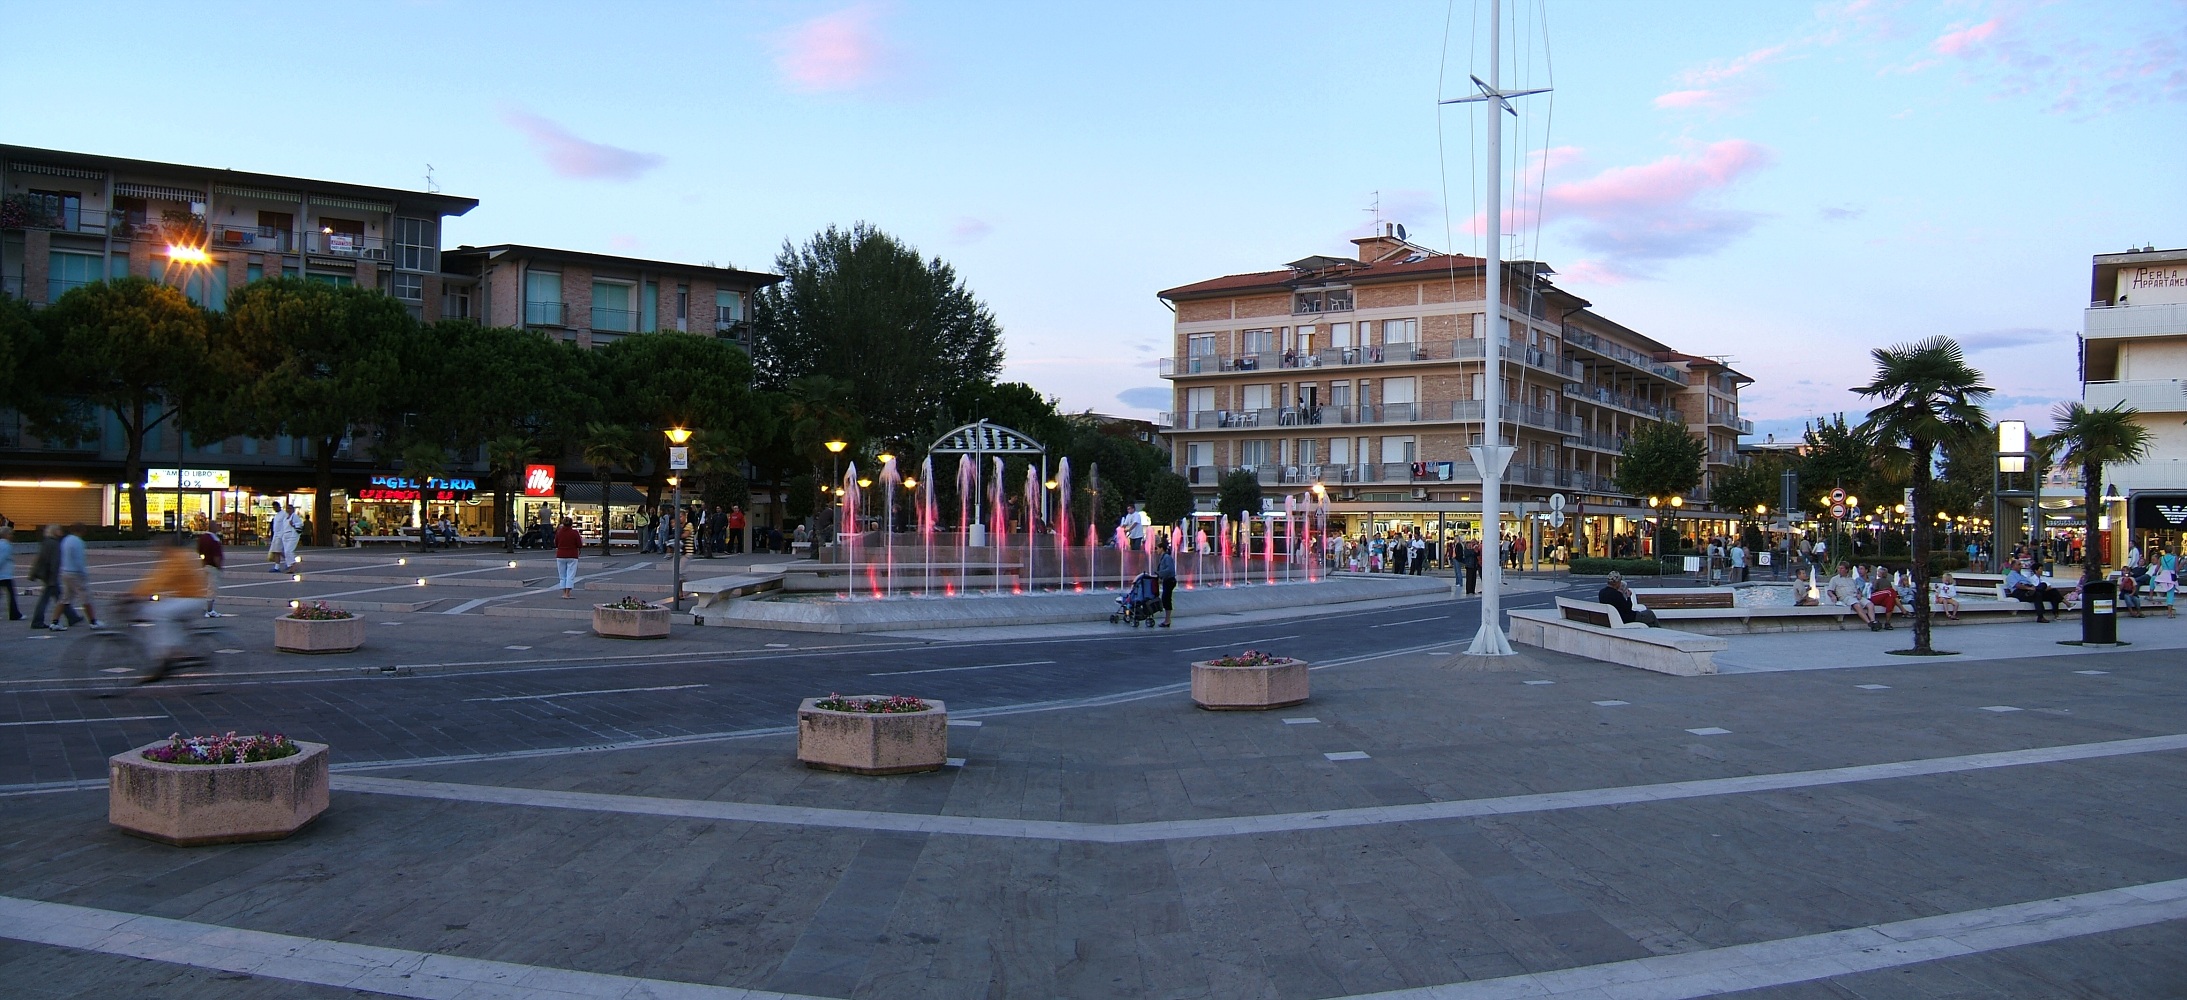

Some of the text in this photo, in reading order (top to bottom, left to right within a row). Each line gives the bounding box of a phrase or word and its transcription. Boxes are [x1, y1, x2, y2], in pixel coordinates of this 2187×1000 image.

[371, 476, 476, 490] LA GELTERIA
[527, 468, 554, 494] illy
